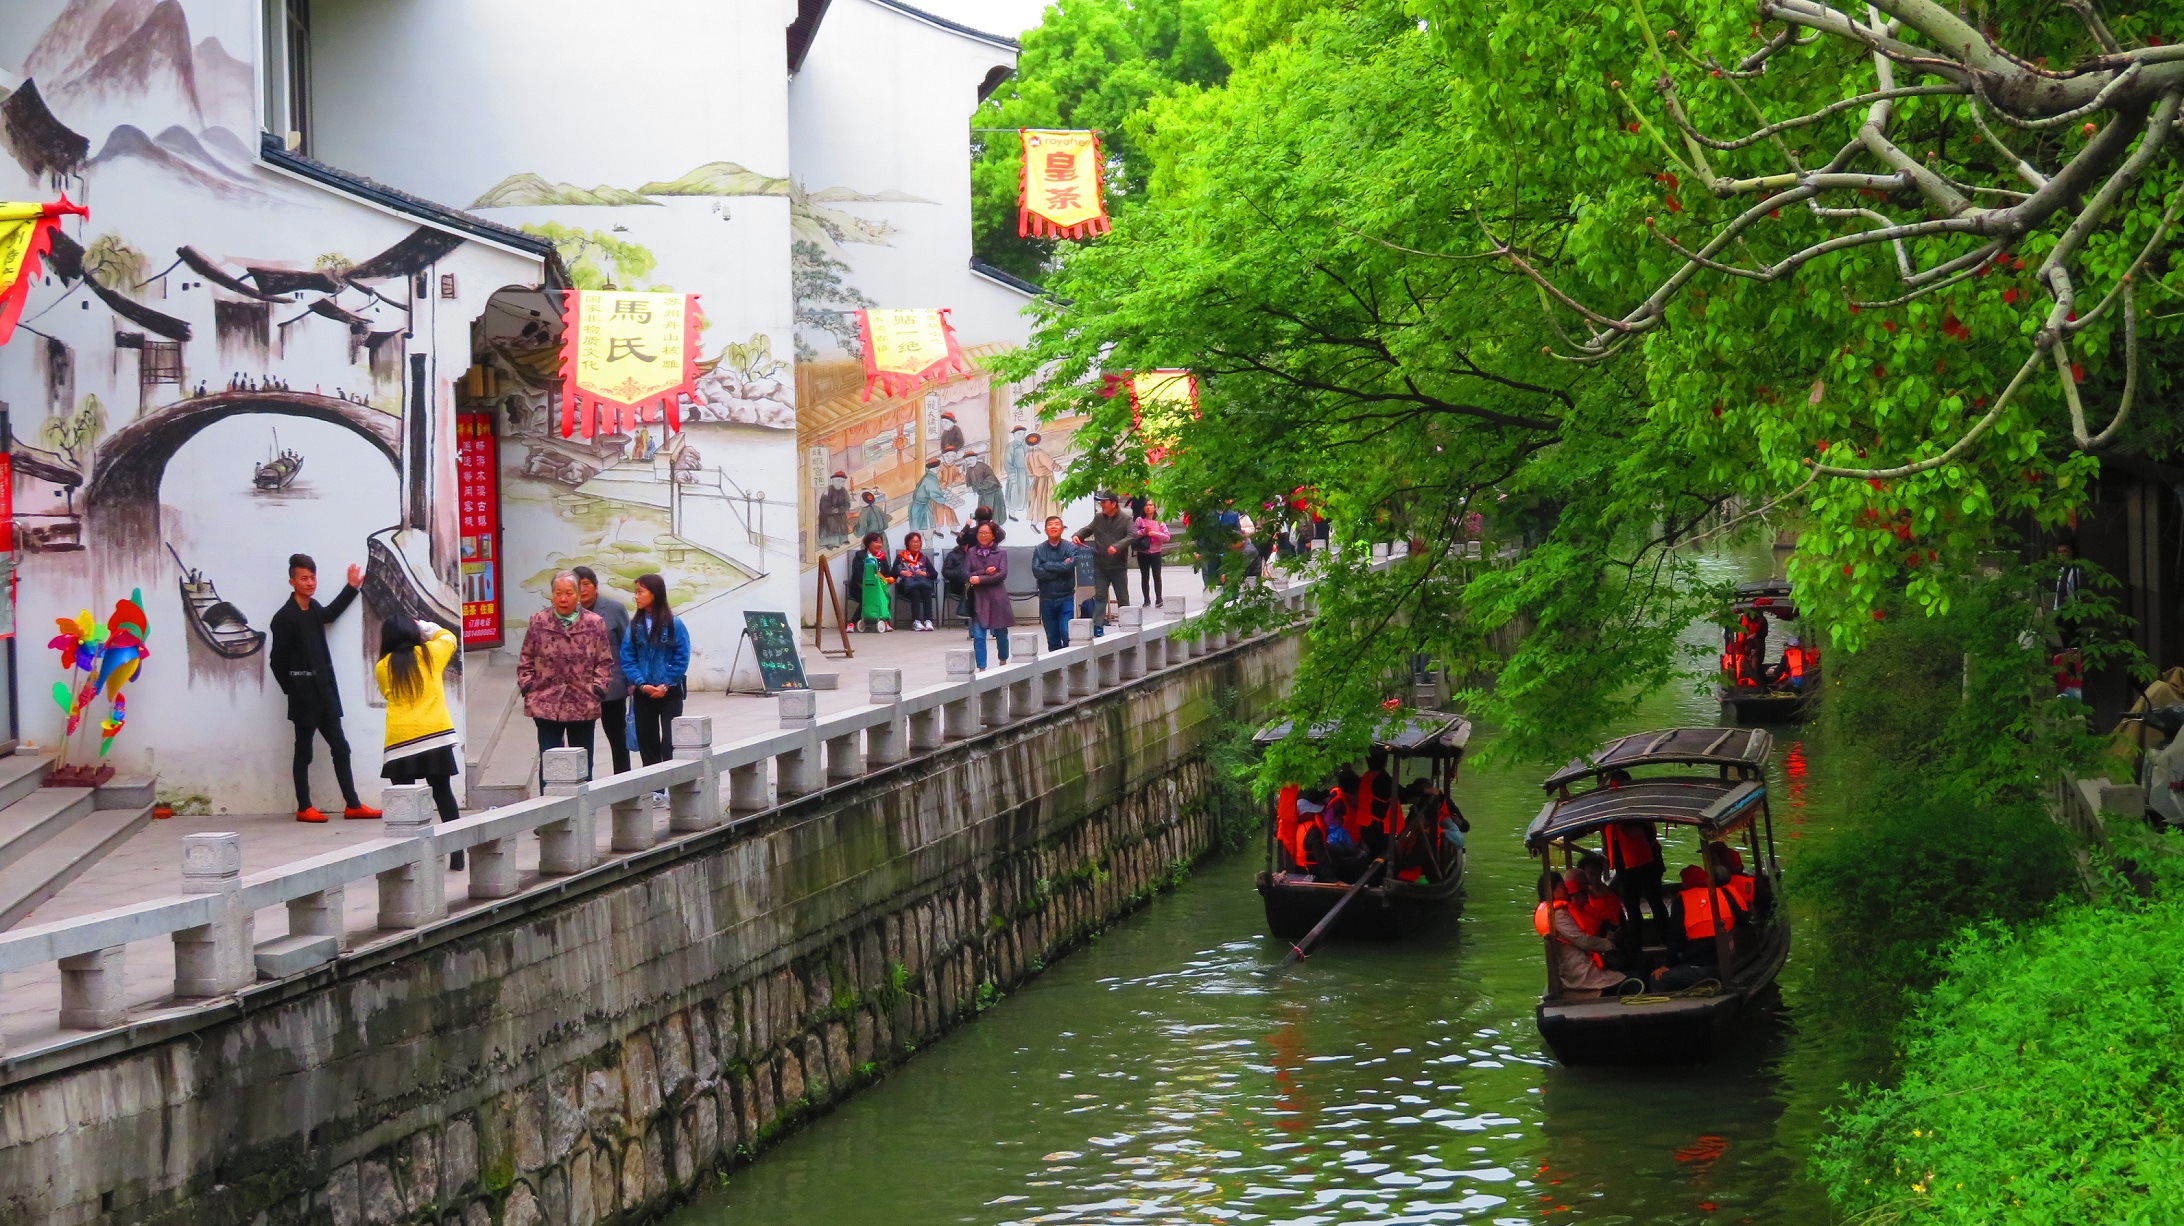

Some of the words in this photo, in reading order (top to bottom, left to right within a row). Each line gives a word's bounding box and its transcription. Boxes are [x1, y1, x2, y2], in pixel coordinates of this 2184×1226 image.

[1043, 151, 1081, 209] 皇茶
[581, 295, 602, 371] 国家非物质文化
[606, 299, 658, 363] 馬氏
[661, 297, 682, 369] 苏州舟山核雕
